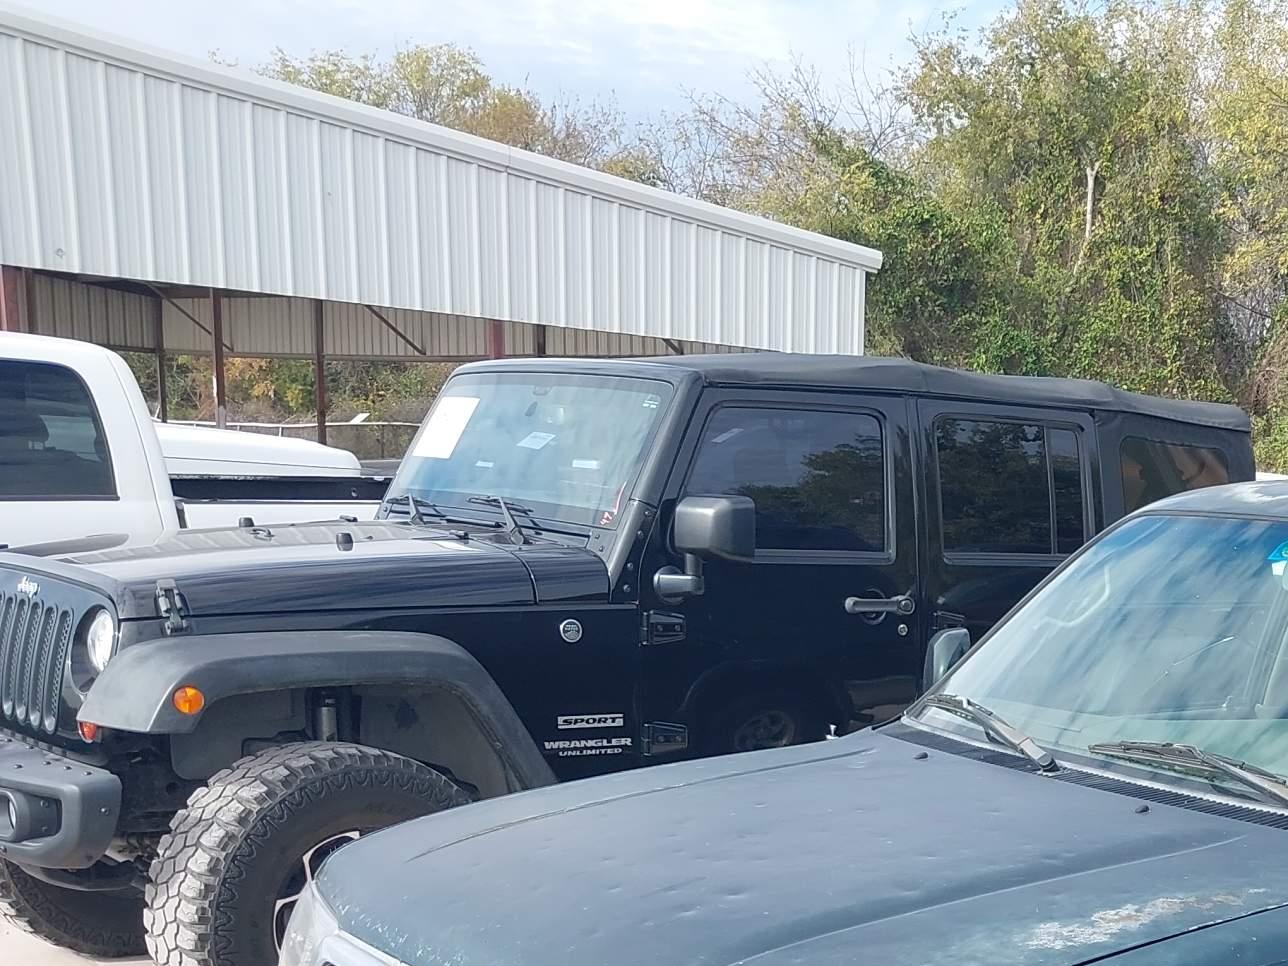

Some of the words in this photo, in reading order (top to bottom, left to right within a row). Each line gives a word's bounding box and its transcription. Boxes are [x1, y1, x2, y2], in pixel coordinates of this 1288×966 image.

[560, 716, 620, 727] SPORT
[544, 738, 632, 749] WRANGLER
[559, 748, 622, 757] UNLIMITED
